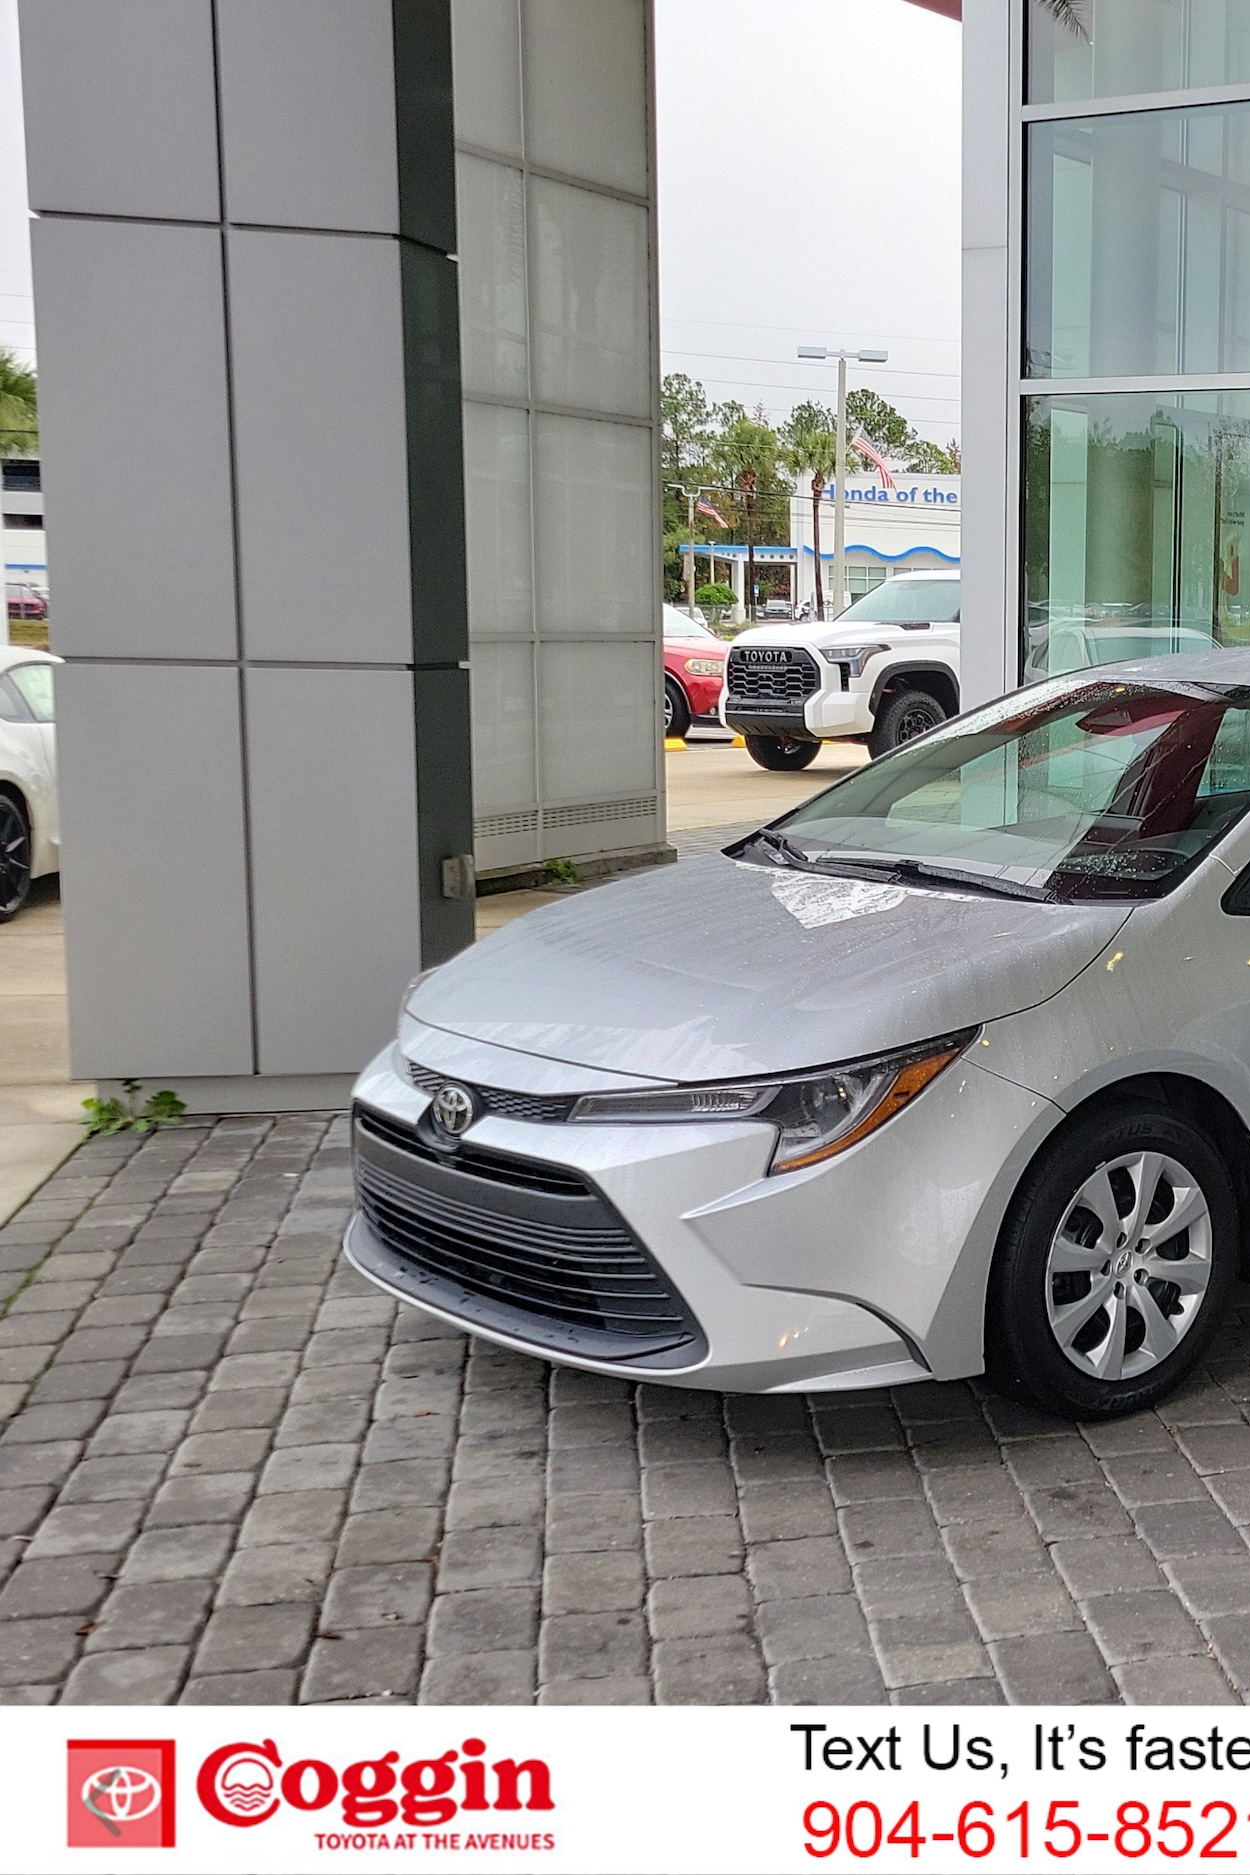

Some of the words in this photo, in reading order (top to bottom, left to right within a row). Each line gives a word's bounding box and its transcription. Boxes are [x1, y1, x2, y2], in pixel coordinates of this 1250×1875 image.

[896, 487, 918, 502] of
[923, 487, 958, 503] the
[744, 651, 787, 662] TOYOTA
